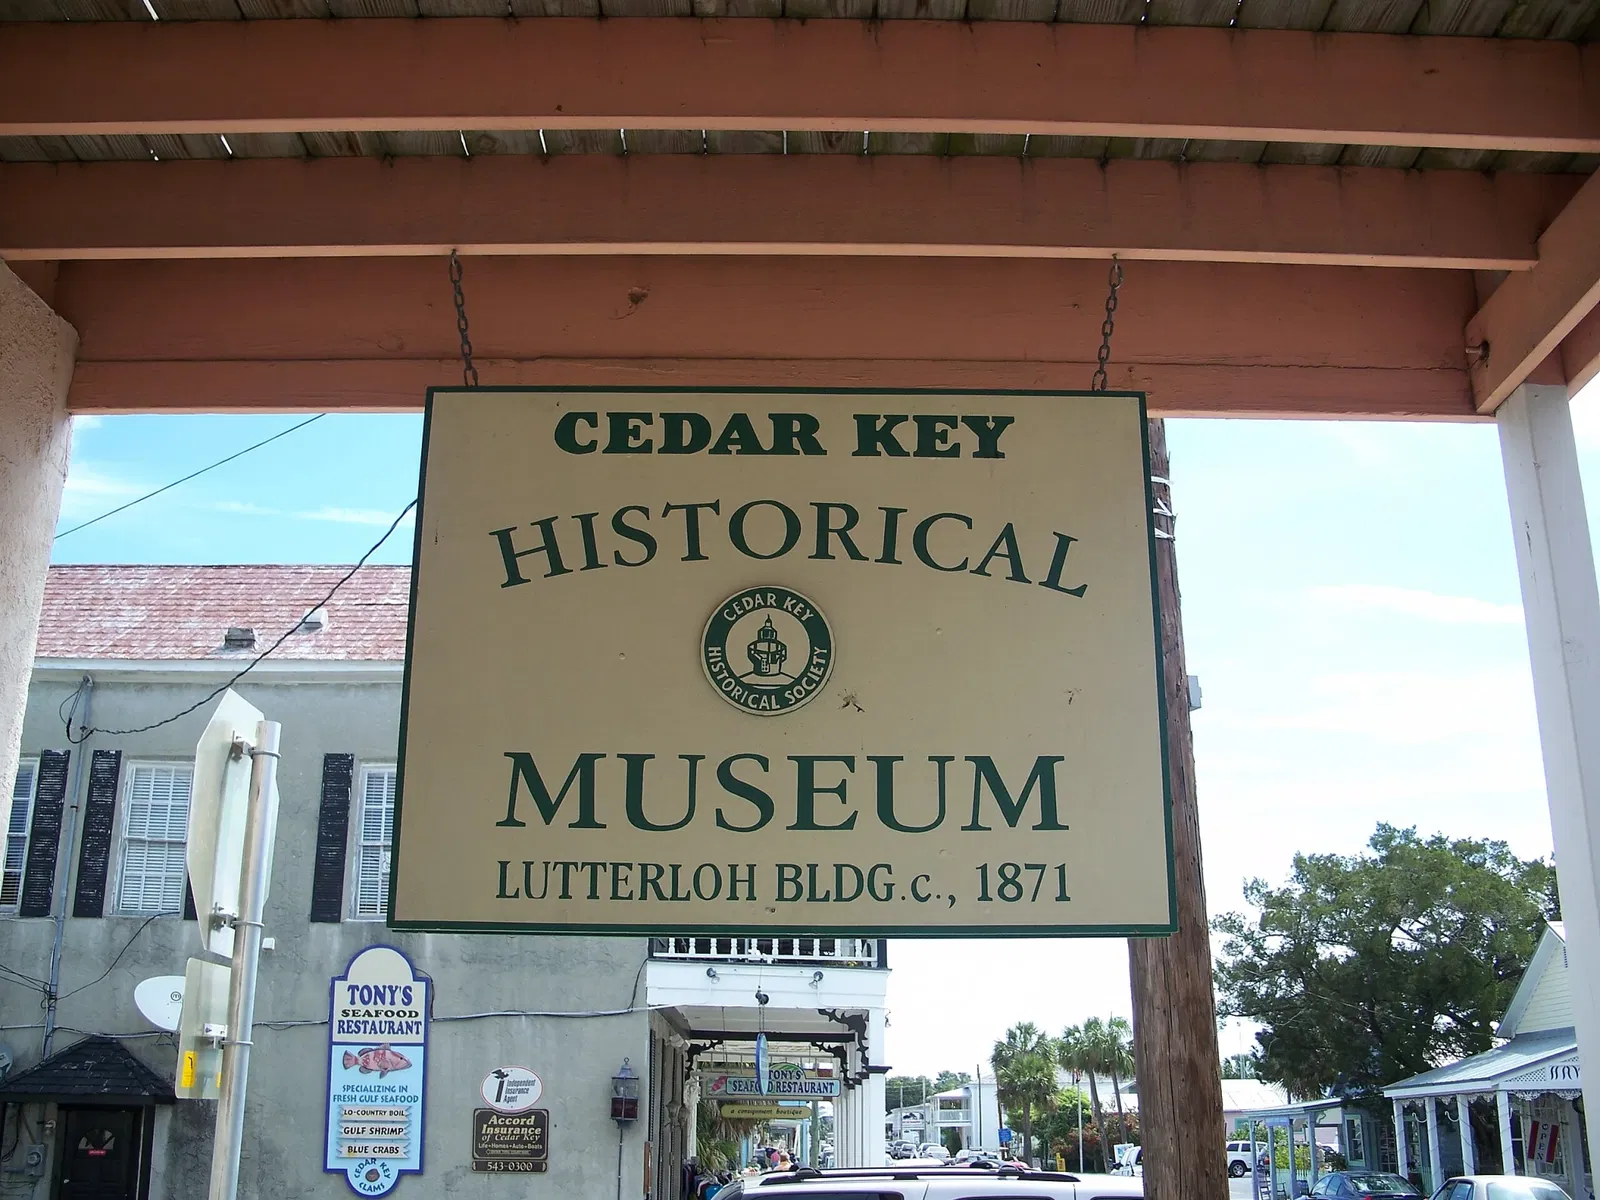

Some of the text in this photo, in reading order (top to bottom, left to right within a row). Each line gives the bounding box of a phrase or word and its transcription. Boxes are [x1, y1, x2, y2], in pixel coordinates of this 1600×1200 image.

[554, 411, 1015, 460] CEDAR KEY
[488, 498, 1089, 600] HISTORICAL
[723, 592, 814, 621] CEDAR KEY
[707, 646, 828, 710] HISTORICAL SOCIETY
[495, 751, 1070, 834] MUSEUM
[496, 860, 757, 902] LUTTERLOH
[976, 862, 1071, 904] 1871
[347, 984, 413, 1006] TONY'S
[341, 1009, 419, 1018] SEAFOOD
[337, 1020, 422, 1035] RESTAURANT
[342, 1085, 396, 1093] SPECIALIZING
[776, 1082, 834, 1093] RESTAURANT
[333, 1095, 419, 1103] FRESH GULF SEAFOOD
[488, 1115, 535, 1125] Accord
[343, 1127, 404, 1135] GULF SHRIMP
[481, 1124, 542, 1135] Insurance
[481, 1135, 491, 1144] of
[523, 1134, 541, 1143] Key
[1537, 1123, 1549, 1160] OPEN
[347, 1146, 400, 1154] BLUE CRABS
[354, 1158, 391, 1179] CEDAR KEY
[487, 1162, 533, 1171] 543-0300
[358, 1182, 385, 1192] CLAMS
